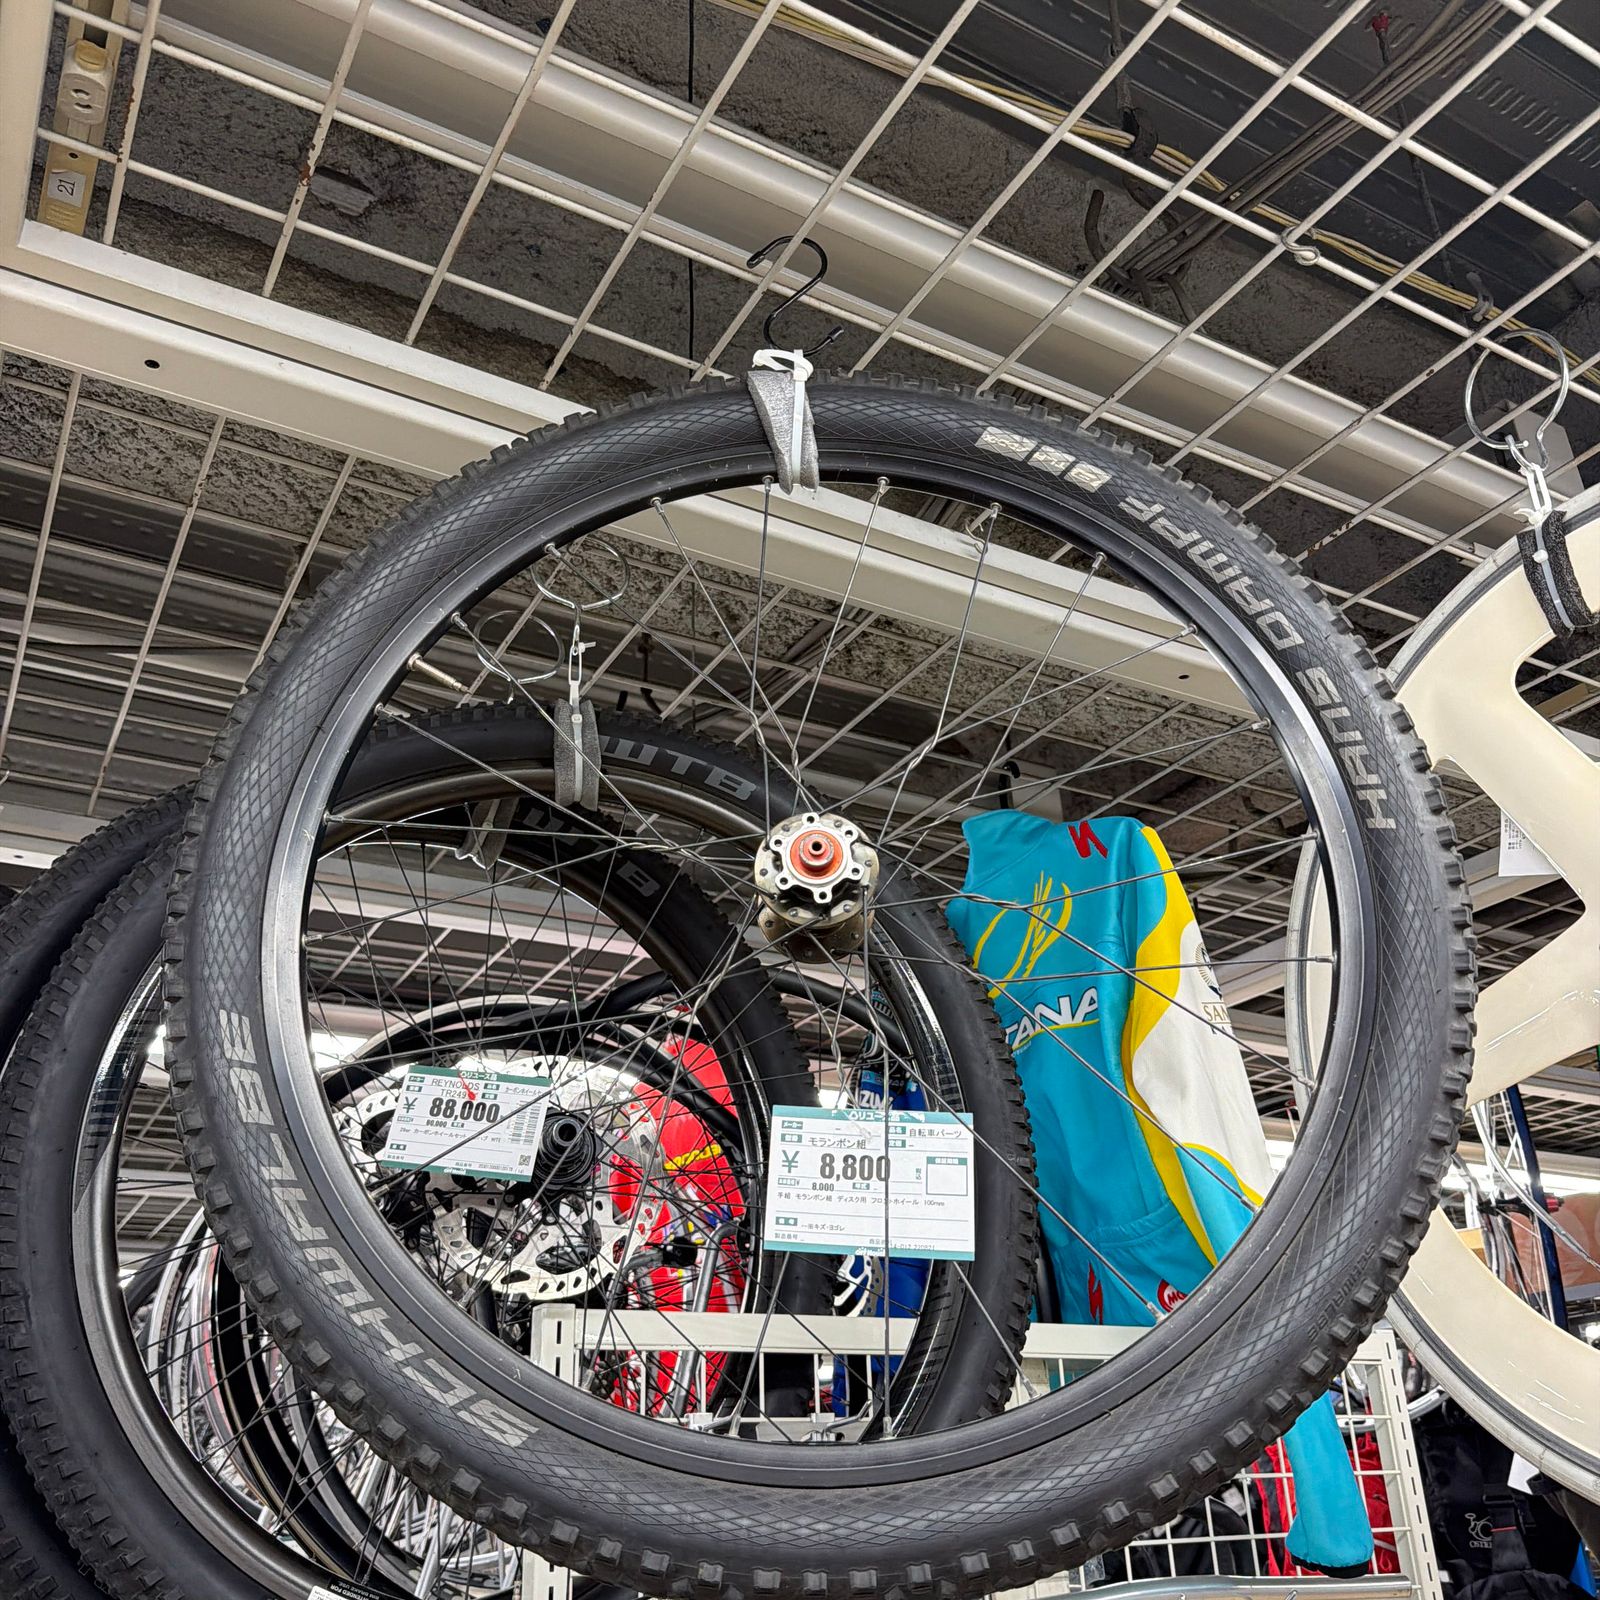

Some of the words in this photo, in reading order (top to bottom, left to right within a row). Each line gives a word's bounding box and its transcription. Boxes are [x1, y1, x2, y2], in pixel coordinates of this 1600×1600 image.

[57, 179, 75, 196] 21
[1119, 496, 1305, 650] DAMPF
[600, 735, 757, 801] WTB
[1299, 667, 1397, 829] HANS
[429, 1097, 500, 1123] 88,000
[909, 1128, 962, 1138] 自転車パーツ
[781, 1150, 800, 1173] ¥
[820, 1153, 890, 1181] 8,800
[220, 1009, 540, 1448] SCHWALBE
